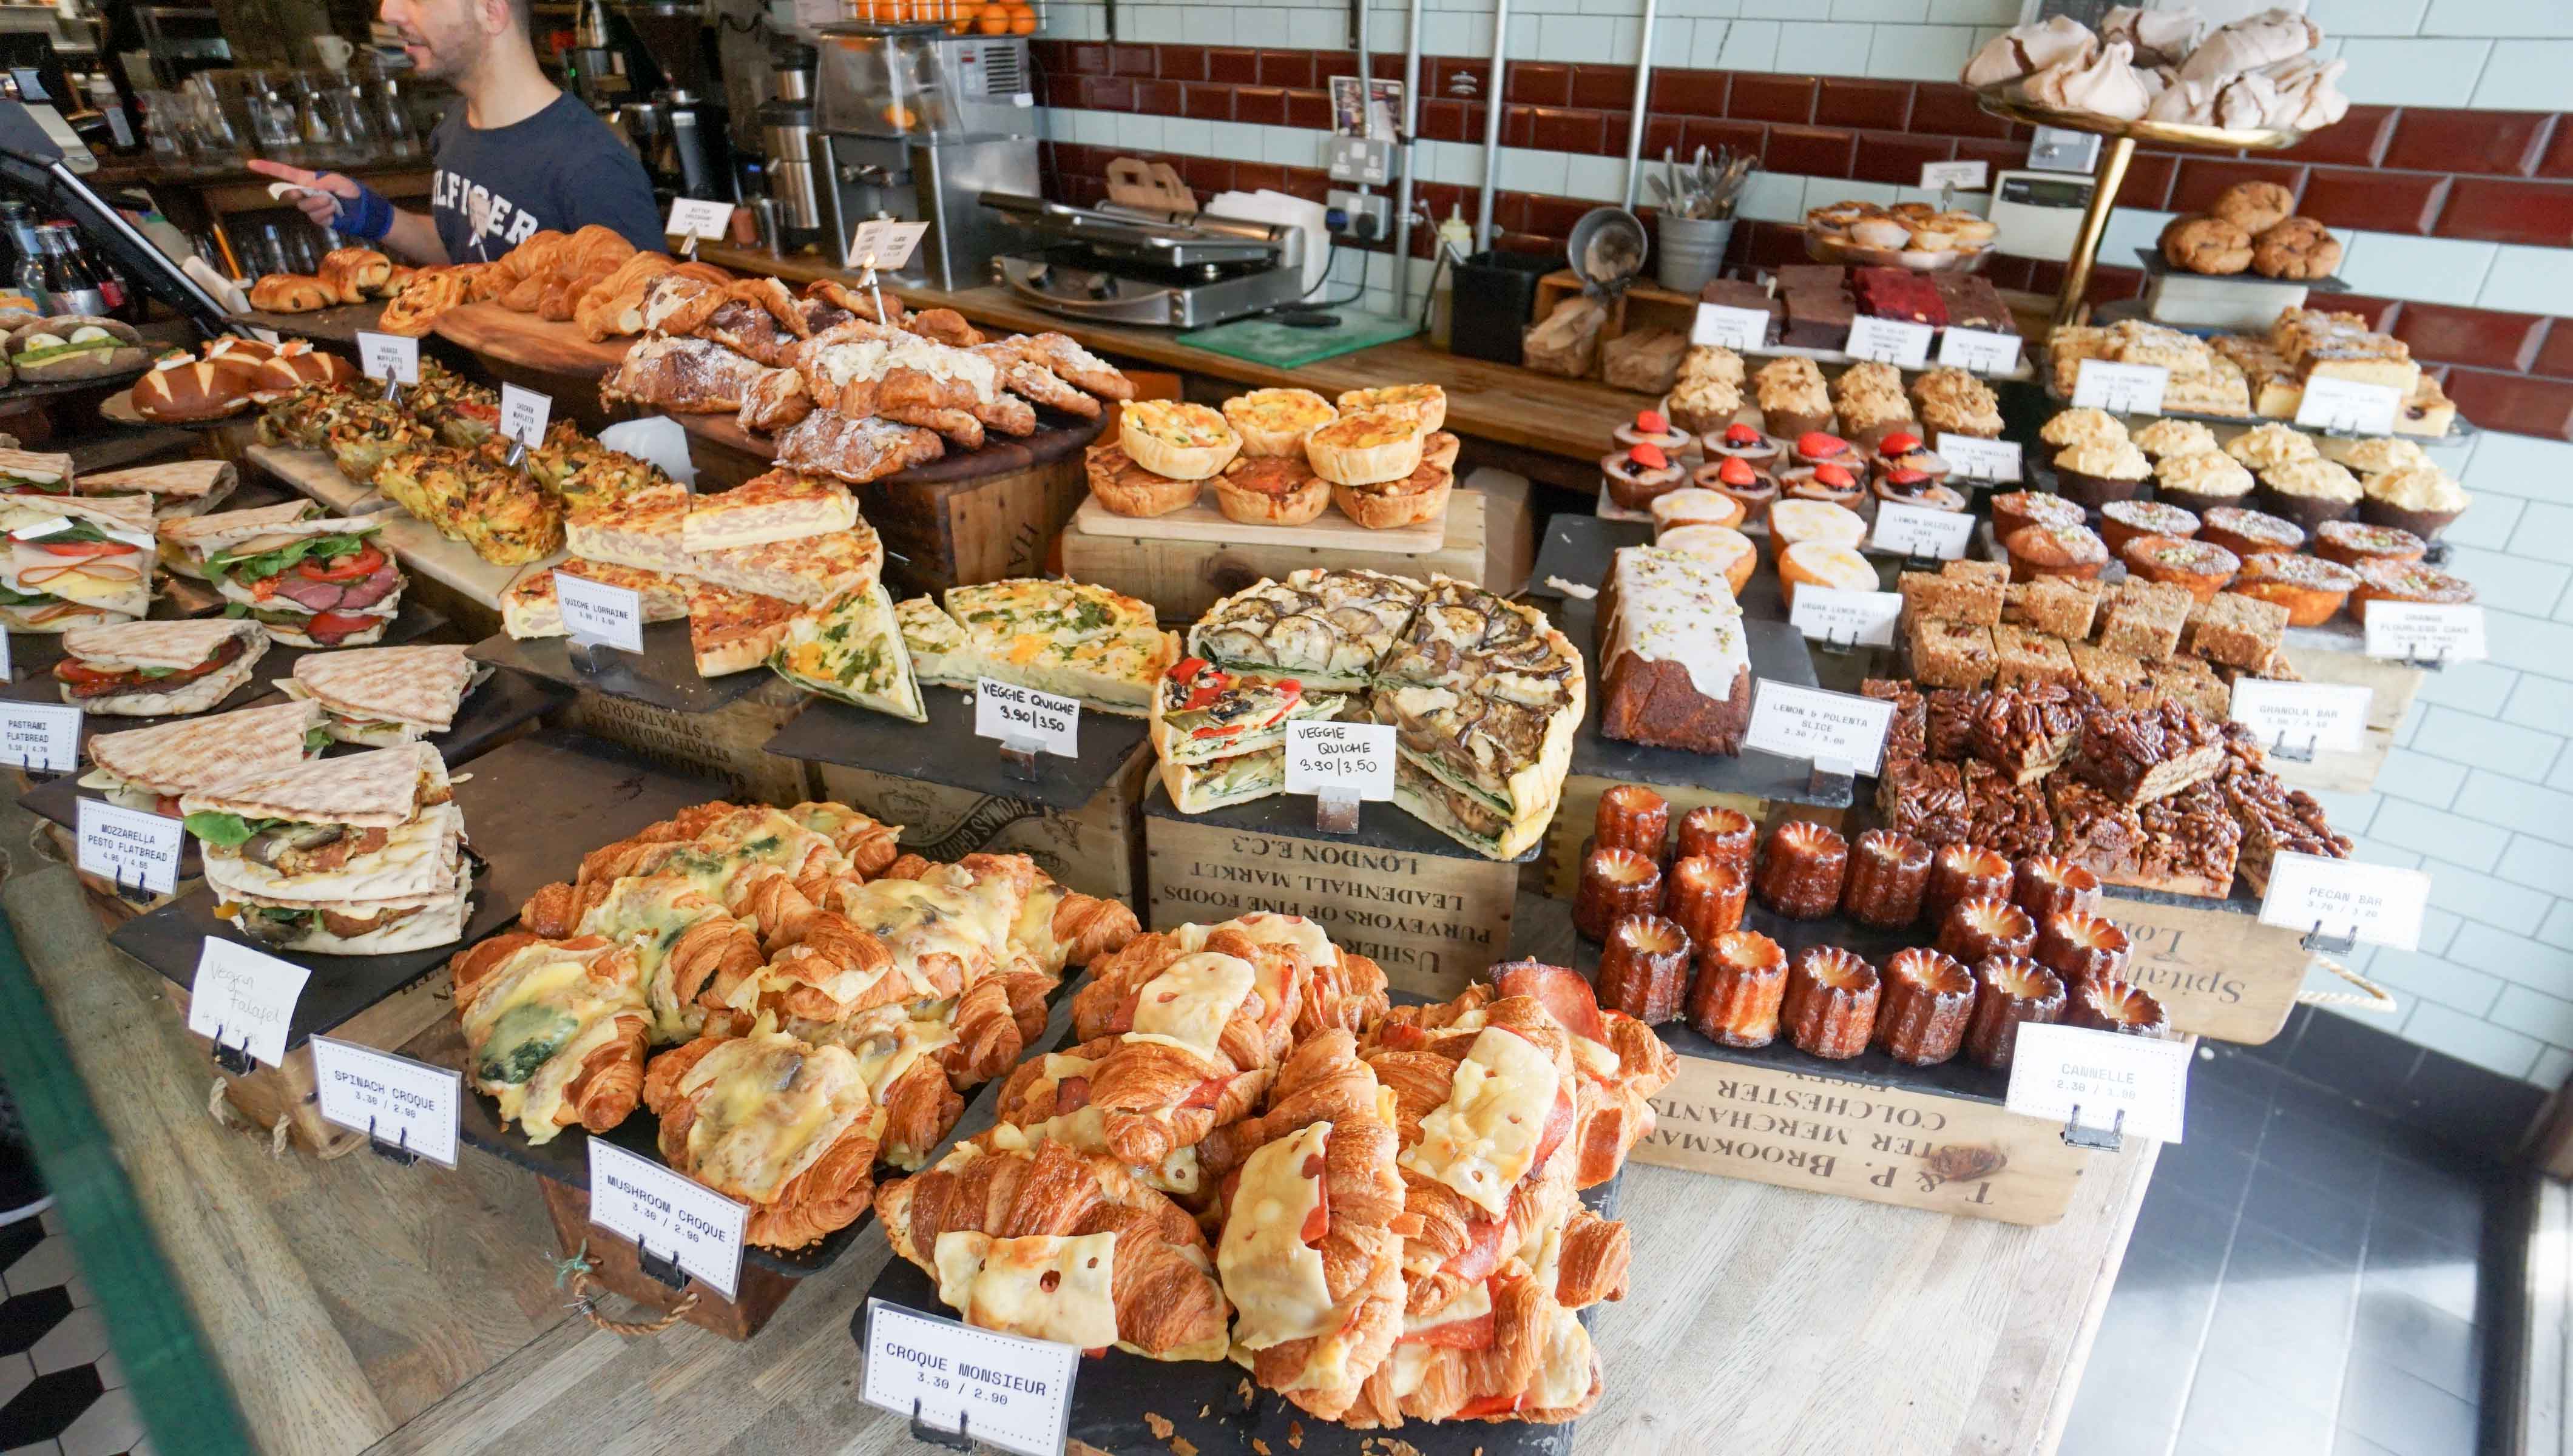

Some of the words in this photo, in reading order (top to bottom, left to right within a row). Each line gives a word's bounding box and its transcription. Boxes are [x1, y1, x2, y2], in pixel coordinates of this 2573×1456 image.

[564, 596, 589, 610] QUICHE
[593, 604, 629, 619] LORRAINE
[982, 682, 1026, 703] VEGGIE
[1030, 695, 1075, 716] QUICHE
[2259, 704, 2310, 718] GRANOLA
[2316, 709, 2339, 718] BAR
[8, 720, 47, 730] PASTRAMI
[598, 699, 703, 738] STRATFORD
[1773, 703, 1805, 715] LEMON
[1823, 712, 1868, 727] POLENTA
[1801, 721, 1834, 733] SLICE
[7, 732, 49, 743] FLATBREAD
[1297, 726, 1346, 740] VEGGIE
[1317, 742, 1371, 755] QUICHE
[971, 796, 1038, 837] THOMAS
[101, 823, 156, 844] MOZZARELLA
[87, 834, 113, 849] PESTO
[118, 842, 167, 862] FLATBREAD
[1231, 835, 1294, 860] E.C.3
[1302, 847, 1419, 875] LONDON
[1190, 861, 1291, 888] MARKET
[1164, 885, 1240, 908] FOODS
[1299, 875, 1465, 911] LEADENHALL
[2308, 886, 2350, 902] PECAN
[2358, 894, 2384, 907] BAR
[1247, 896, 1300, 916] FINE
[1307, 905, 1338, 922] OF
[1344, 909, 1492, 945] PURVEYORS
[1344, 939, 1441, 973] USHER
[211, 960, 254, 992] Vegan
[2125, 965, 2247, 1004] Spital
[229, 989, 281, 1025] Falafel
[2056, 1079, 2086, 1092] 2.30
[2061, 1063, 2135, 1084] CANNELLE
[334, 1070, 385, 1094] SPINACH
[392, 1087, 436, 1111] CROQUE
[356, 1091, 378, 1105] 3.30
[1717, 1079, 1947, 1131] COLCHESTER
[1645, 1097, 1853, 1146] MERCHANTS
[1915, 1170, 1946, 1193] &
[1966, 1181, 1994, 1205] T
[607, 1174, 671, 1214] MUSHROOM
[678, 1209, 727, 1243] CROQUE
[632, 1201, 657, 1221] 3.30
[886, 1342, 948, 1372] CROQUE
[958, 1362, 1047, 1397] MONSIEUR
[917, 1371, 950, 1389] 3.30
[973, 1387, 1008, 1406] 2.90
